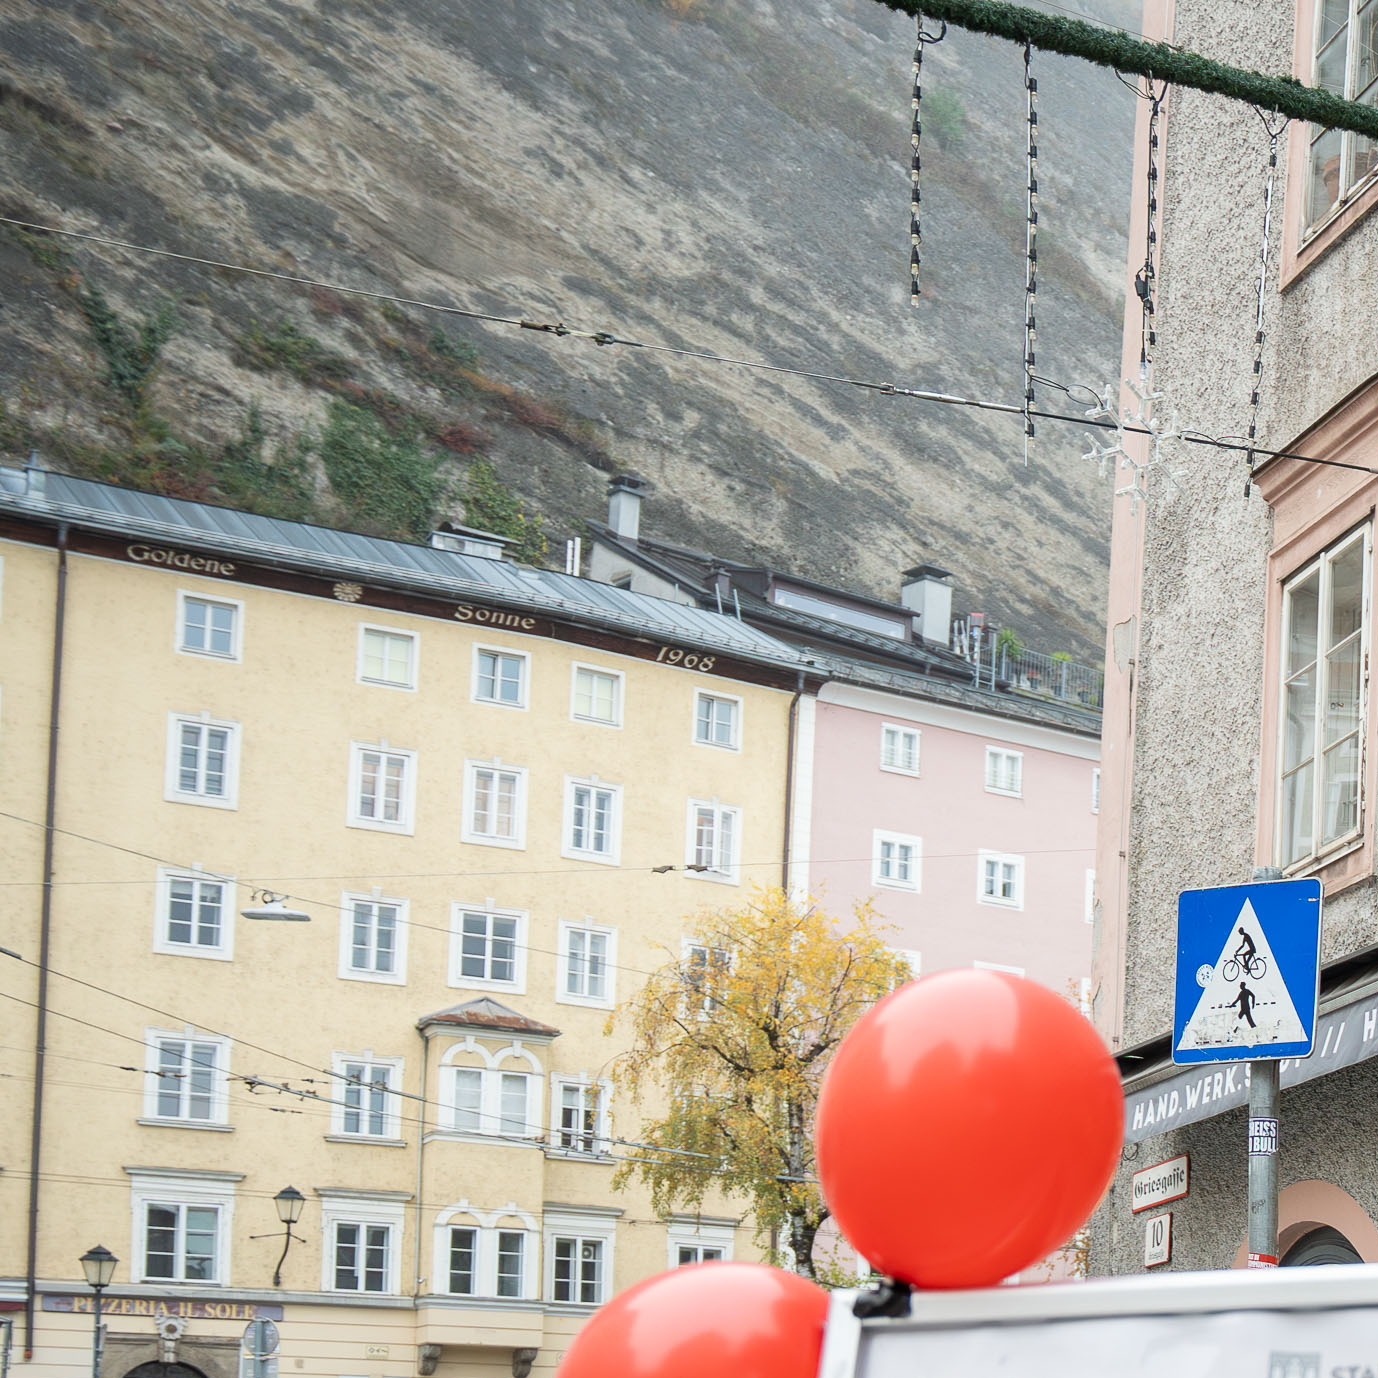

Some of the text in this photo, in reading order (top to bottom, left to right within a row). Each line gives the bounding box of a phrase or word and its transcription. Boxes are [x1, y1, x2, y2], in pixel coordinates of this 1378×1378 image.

[126, 544, 716, 673] Goldene Sonne 1968
[1151, 1220, 1164, 1248] 10
[179, 1301, 200, 1317] IL
[204, 1302, 257, 1320] SOLE
